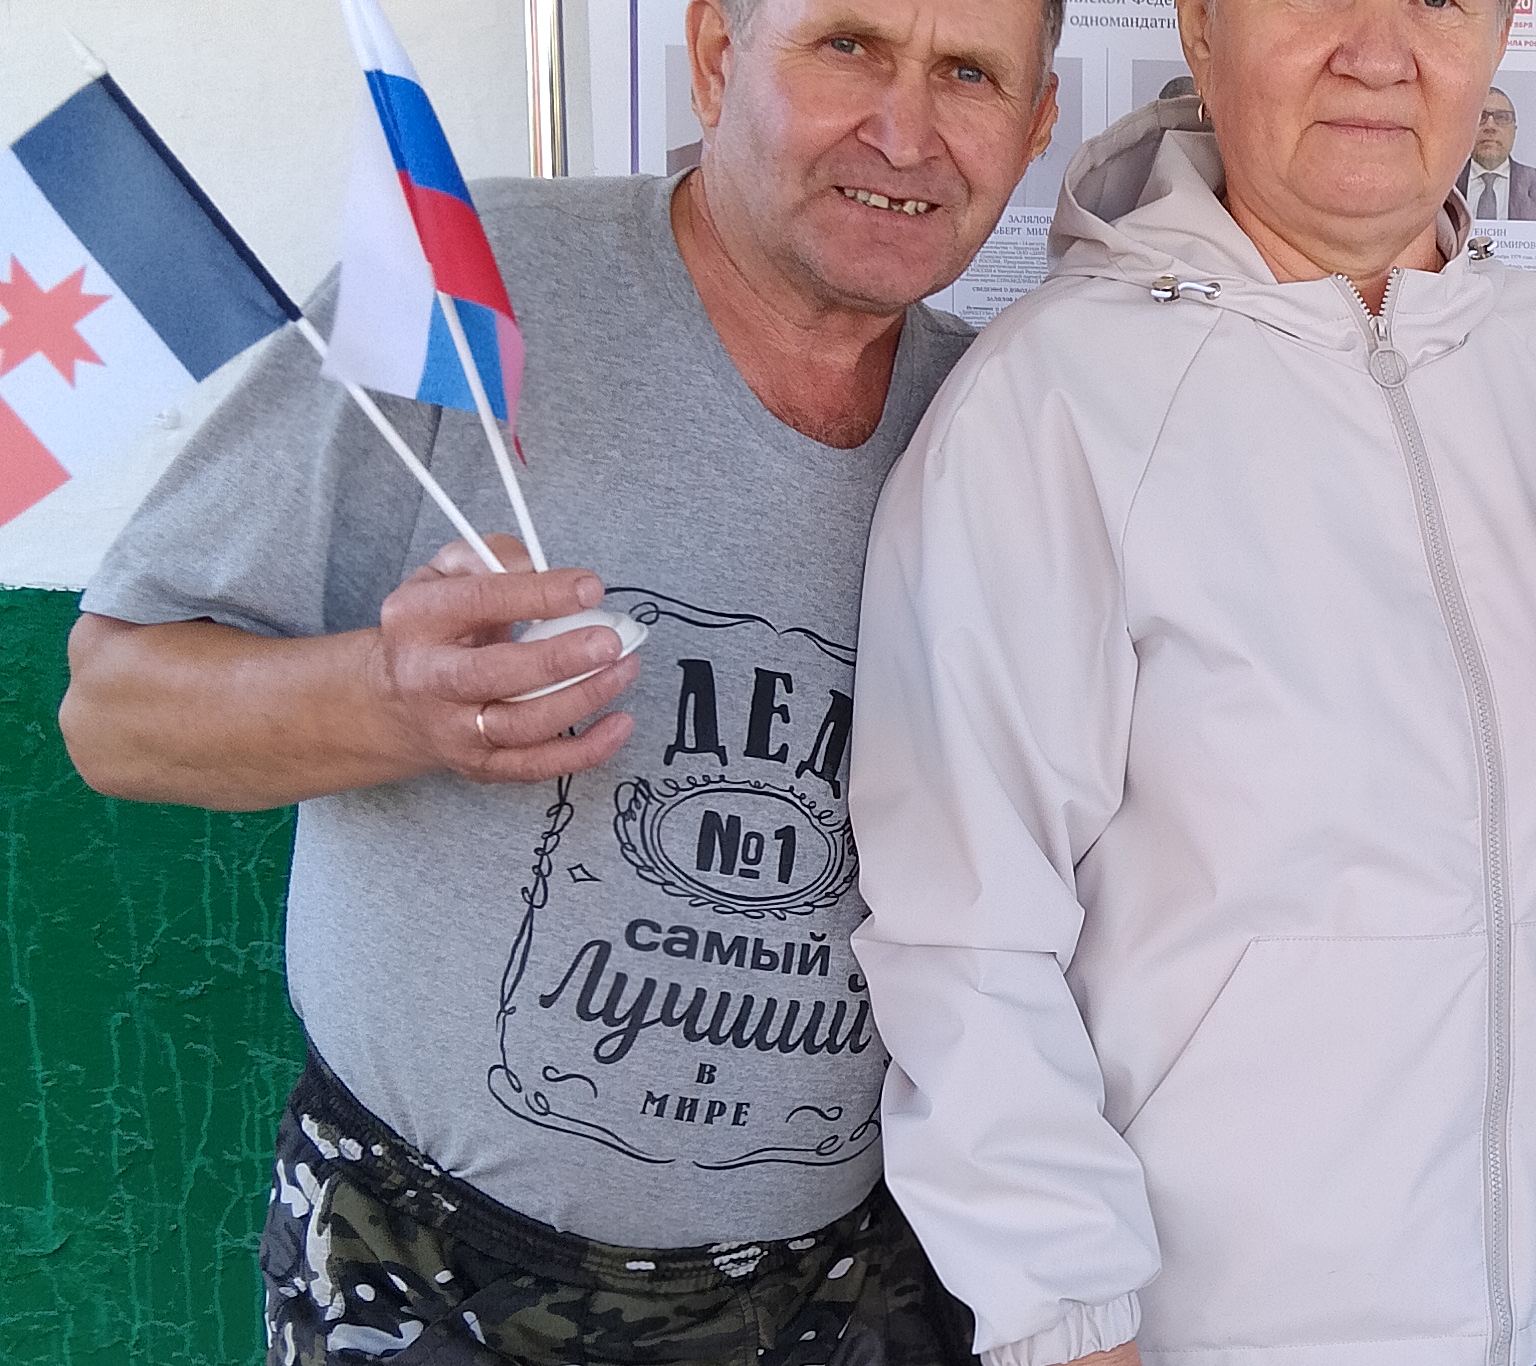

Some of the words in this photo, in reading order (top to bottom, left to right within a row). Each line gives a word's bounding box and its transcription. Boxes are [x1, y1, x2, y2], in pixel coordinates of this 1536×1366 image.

[1070, 16, 1176, 29] одномандатн
[994, 227, 1022, 235] ЬБЕРТ
[1027, 227, 1048, 235] МИЛ
[664, 659, 854, 799] ДЕД
[697, 810, 796, 884] №1
[625, 917, 831, 976] самый
[540, 939, 869, 1064] Лучший
[640, 1091, 750, 1126] МИРЕ
